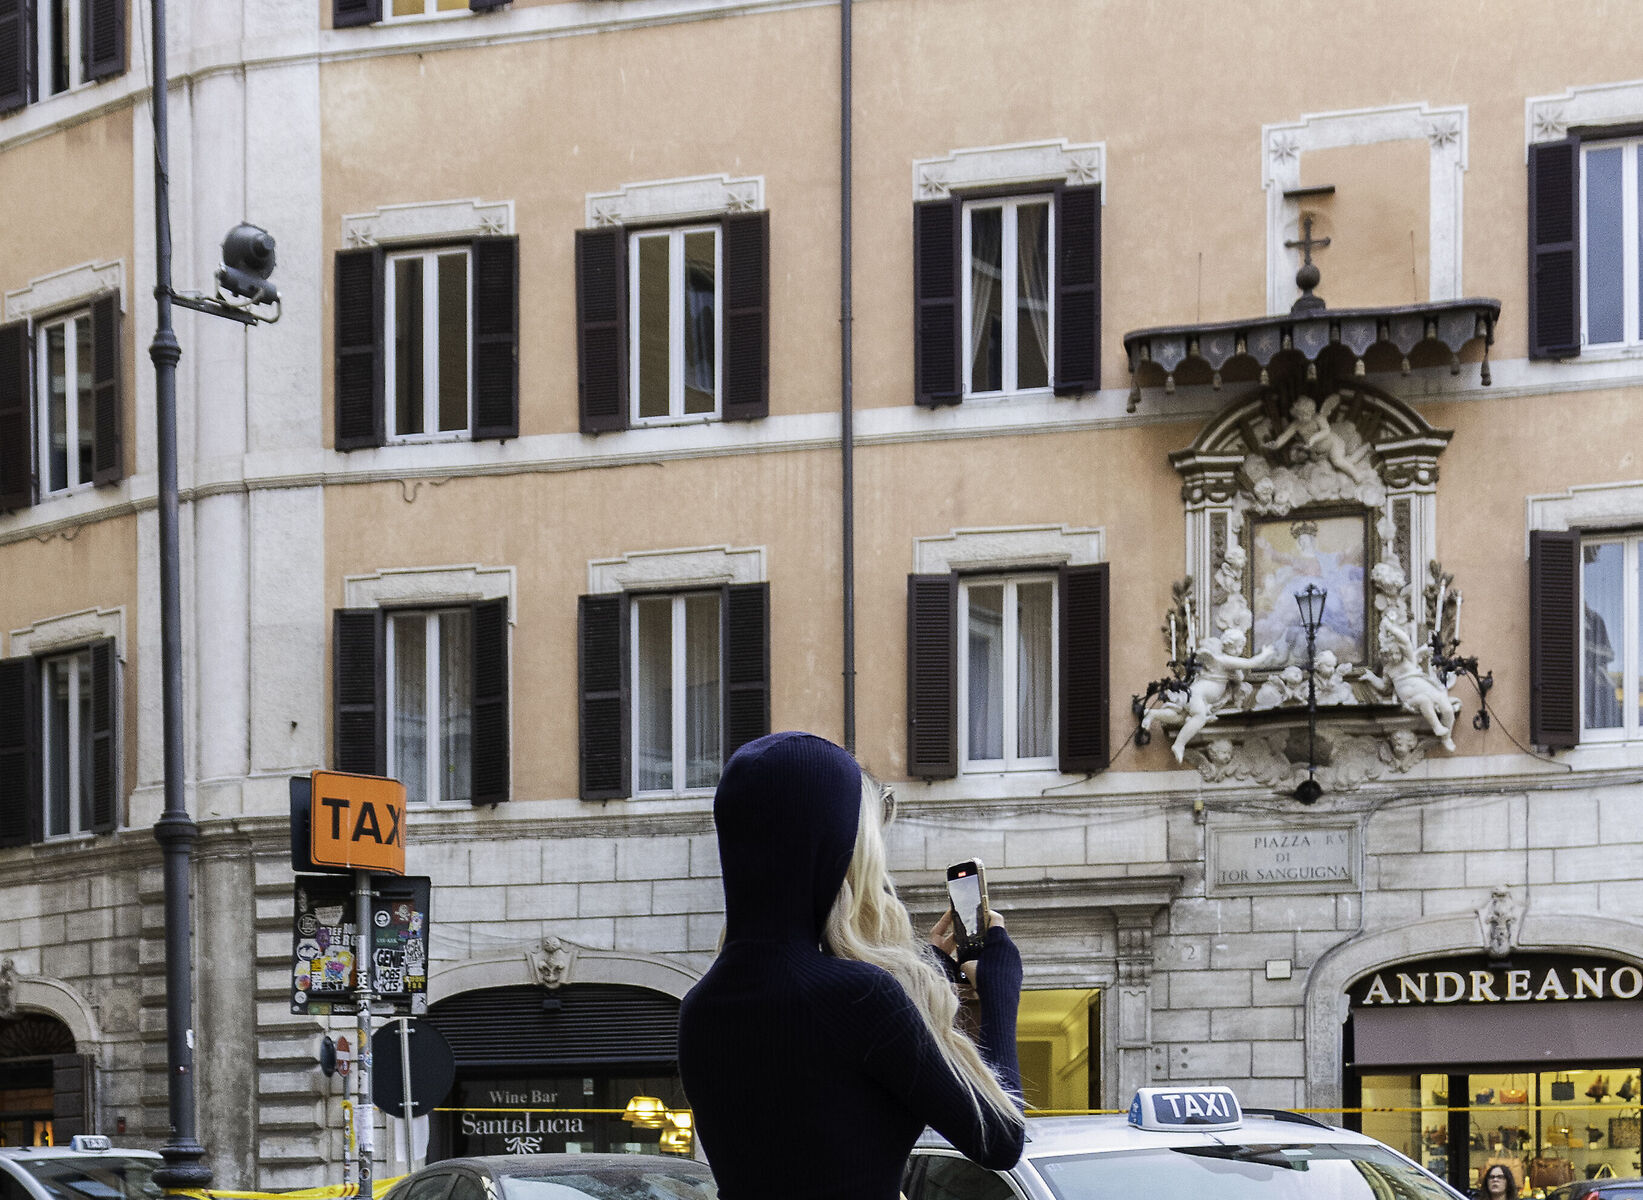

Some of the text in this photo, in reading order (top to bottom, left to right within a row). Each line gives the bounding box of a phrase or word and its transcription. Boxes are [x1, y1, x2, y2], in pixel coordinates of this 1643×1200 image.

[1254, 836, 1311, 849] PIAZZA
[1276, 853, 1290, 863] DI
[1219, 866, 1348, 883] TOR SANGUIGNA
[1362, 966, 1643, 1005] ANDREANO
[490, 1089, 558, 1104] Wine Bar
[1161, 1093, 1231, 1118] TAXI
